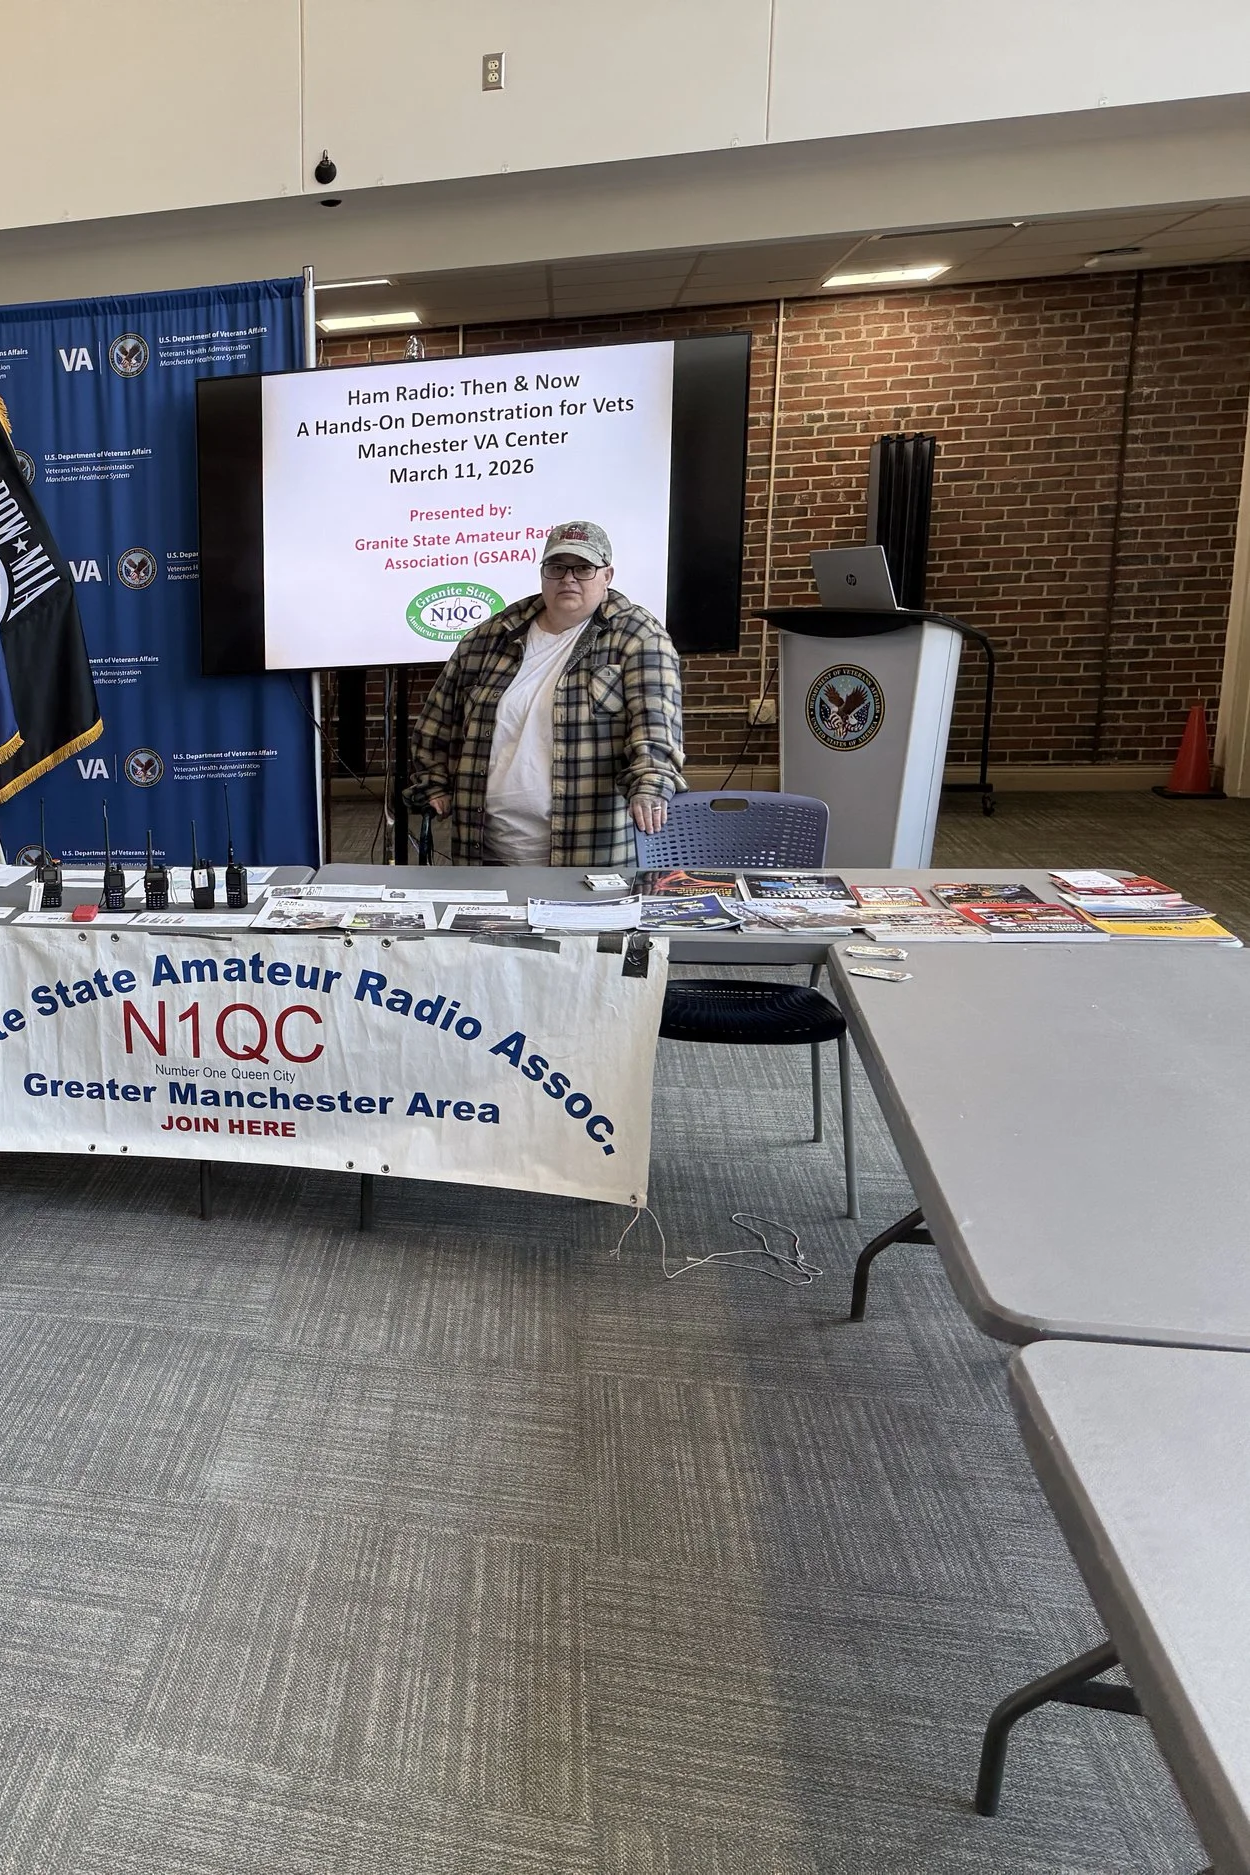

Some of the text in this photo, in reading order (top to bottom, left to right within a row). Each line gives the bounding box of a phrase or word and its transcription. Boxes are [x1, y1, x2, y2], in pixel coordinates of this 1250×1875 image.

[159, 336, 171, 344] U.S.
[173, 333, 211, 344] Department
[219, 330, 247, 338] Veterans
[248, 326, 267, 334] Affairs
[8, 348, 28, 356] Affairs
[59, 348, 94, 372] VA
[160, 349, 185, 358] Veterans
[348, 372, 580, 406] Ham Radio: Then & Now
[297, 396, 634, 438] A Hands-On Demonstration for Vets
[58, 452, 96, 461] Department
[132, 448, 152, 456] Affairs
[358, 428, 569, 460] Manchester VA Center
[390, 458, 534, 485] March 11, 2026
[410, 504, 512, 523] Presented by:
[355, 534, 409, 552] Granite
[414, 532, 451, 549] State
[455, 528, 521, 546] Amateur
[385, 546, 537, 570] Association (GSARA)
[6, 543, 61, 622] MIA
[69, 560, 102, 583] VA
[416, 586, 496, 608] Granite State
[409, 616, 462, 640] Amateur Radio
[810, 672, 832, 709] DEPARTMENT
[186, 752, 222, 761] Department
[77, 759, 110, 780] VA
[123, 1000, 324, 1065] N1QC
[30, 968, 138, 1017] State
[152, 952, 342, 993] Amateur
[353, 968, 483, 1041] Radio
[488, 1030, 616, 1156] Assoc.
[155, 1064, 296, 1084] Number One Queen City
[23, 1072, 501, 1124] Greater Manchester Area
[160, 1115, 296, 1138] JOIN HERE
